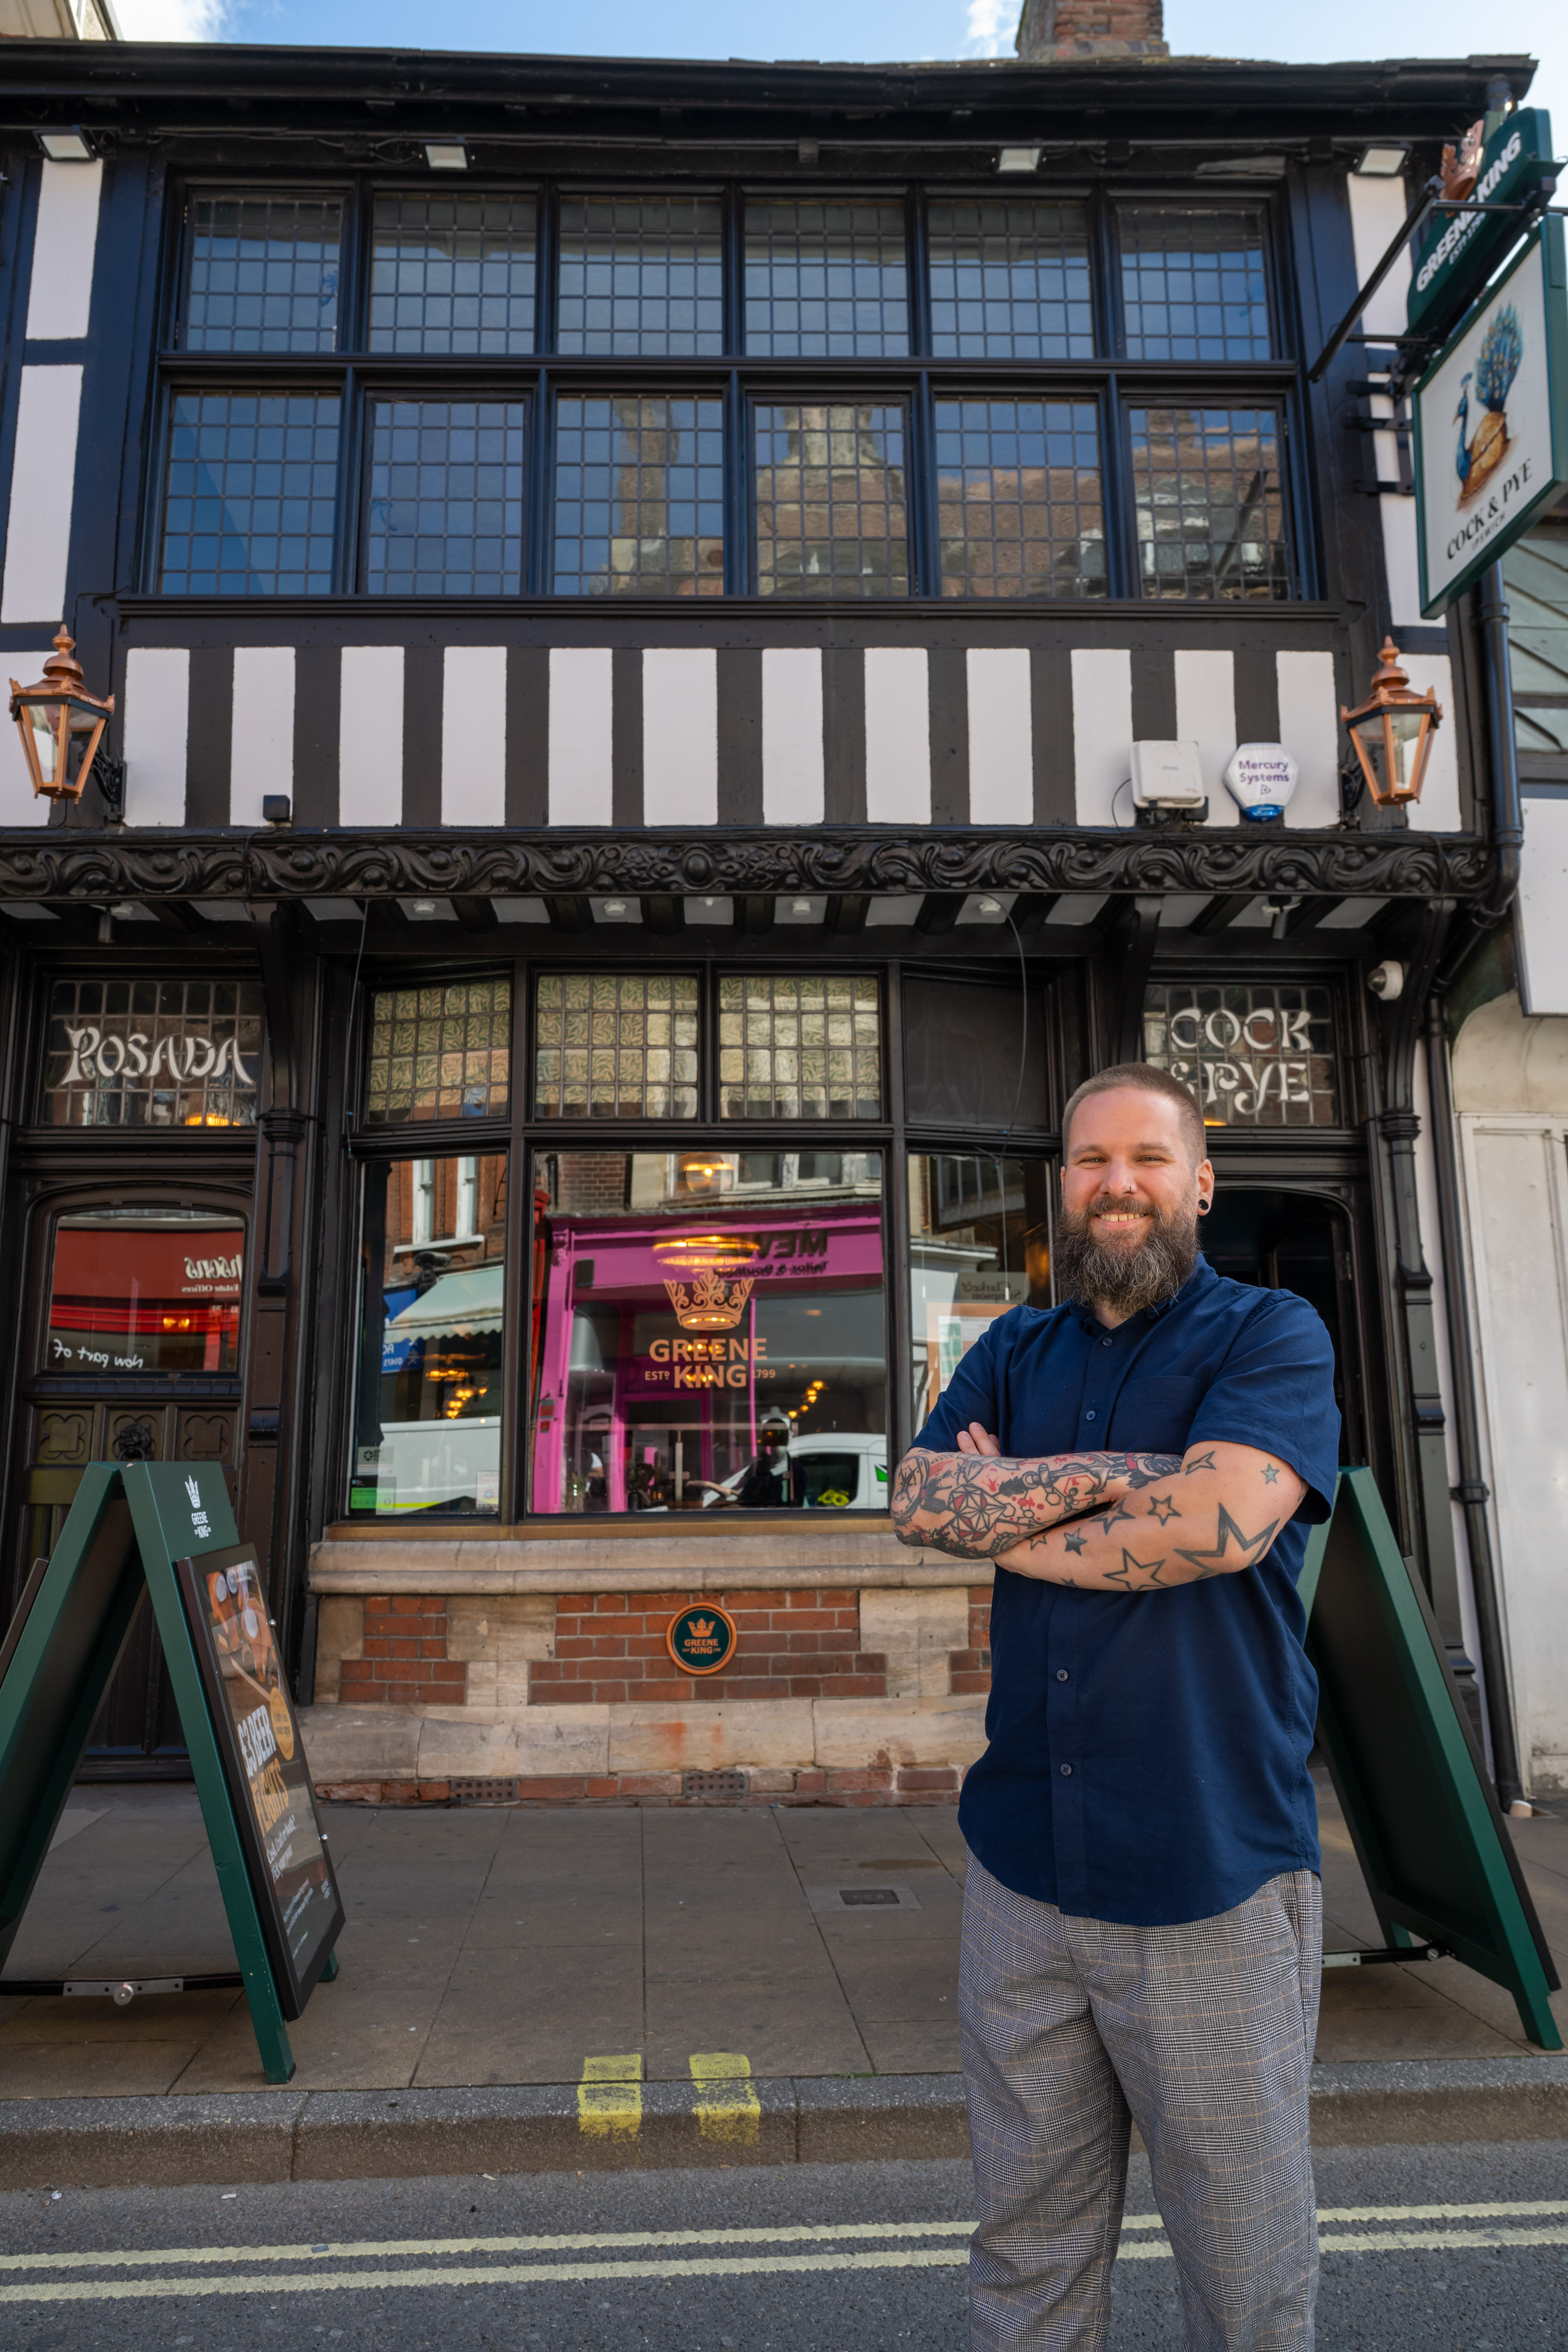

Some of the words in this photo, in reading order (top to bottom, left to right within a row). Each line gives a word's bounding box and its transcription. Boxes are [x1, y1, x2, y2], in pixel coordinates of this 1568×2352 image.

[1477, 132, 1521, 203] KING
[1447, 508, 1484, 559] COCK
[1488, 496, 1498, 518] &
[1503, 458, 1532, 503] PYE
[1472, 512, 1505, 550] IPSWICH
[1239, 760, 1288, 772] Mercury
[1240, 773, 1289, 785] Systems
[1171, 1008, 1311, 1051] COCK
[60, 1025, 255, 1085] POSADA
[1203, 1062, 1309, 1114] PYE
[649, 1338, 768, 1363] GREENE
[674, 1365, 747, 1389] KING
[751, 1369, 776, 1379] 1799
[191, 1511, 209, 1525] GREENE
[197, 1525, 209, 1538] KING
[238, 1720, 257, 1779] £3
[247, 1704, 276, 1768] BEER
[250, 1757, 289, 1838] FLIGHTS
[271, 1861, 281, 1884] Pick
[278, 1853, 287, 1877] your
[285, 1843, 293, 1866] pour
